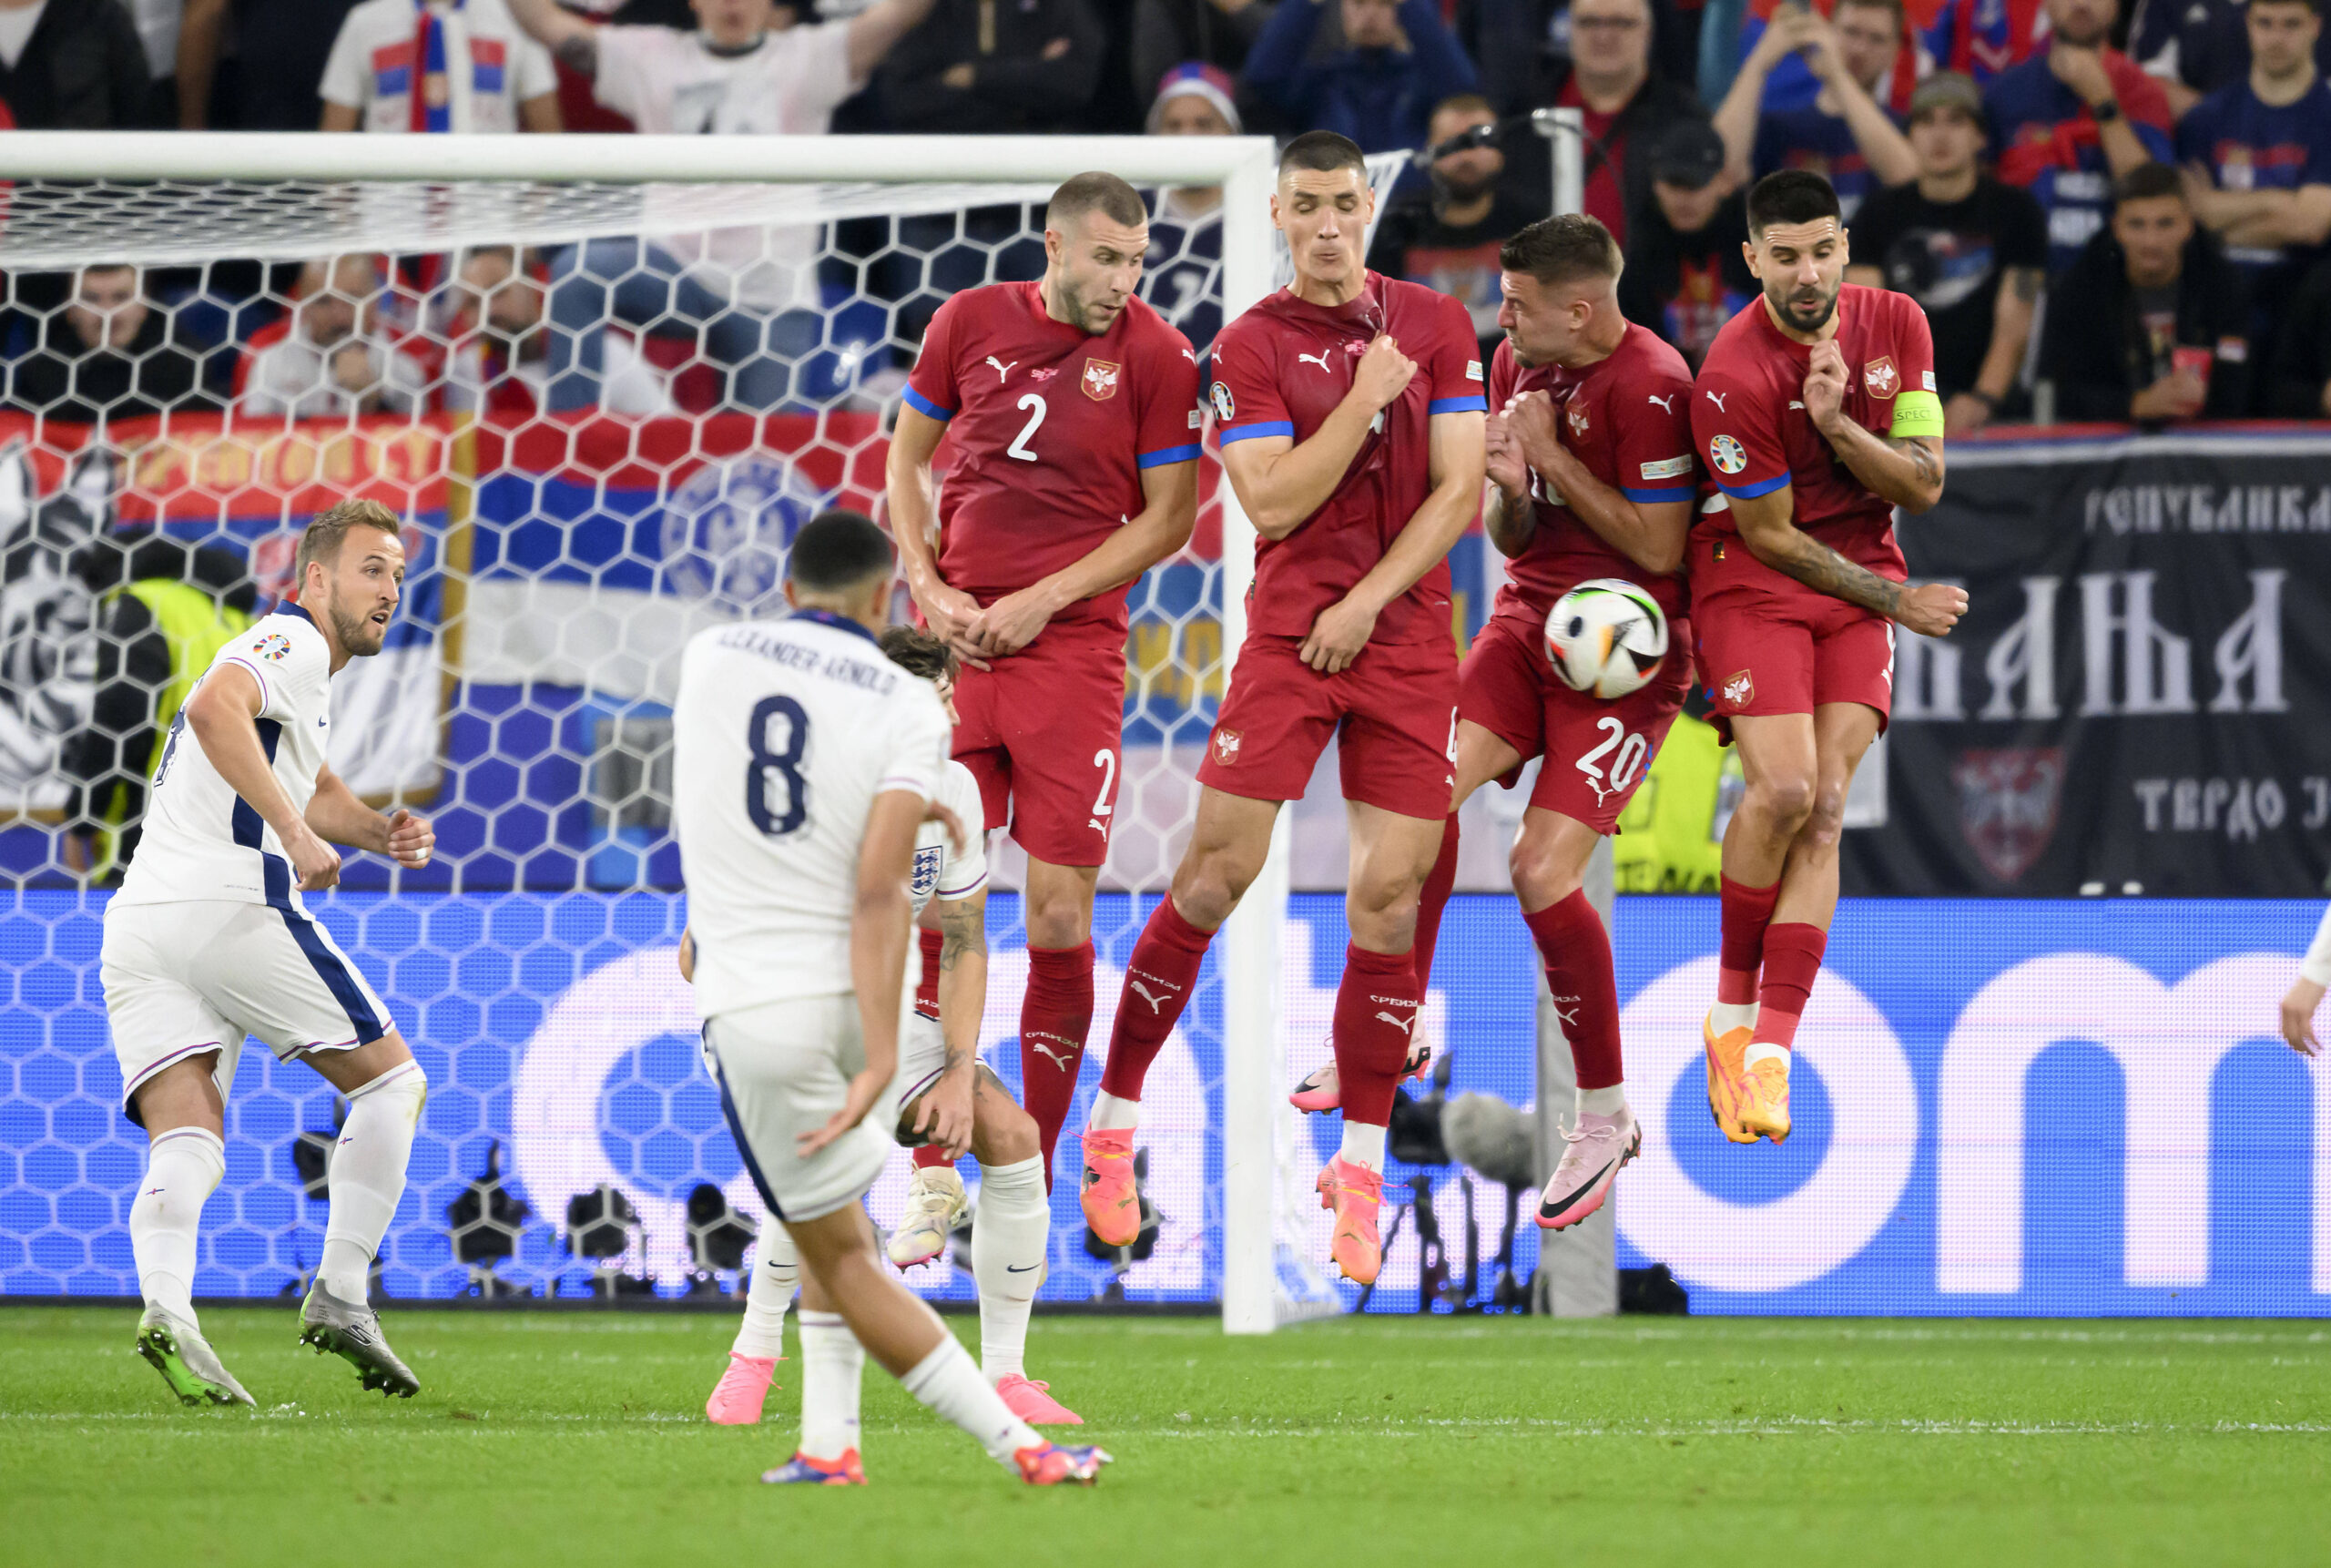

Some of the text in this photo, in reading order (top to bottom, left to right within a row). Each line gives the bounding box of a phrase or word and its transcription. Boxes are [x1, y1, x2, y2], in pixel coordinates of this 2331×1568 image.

[1006, 392, 1047, 462] 2
[747, 694, 809, 836] 8
[1092, 748, 1115, 816] 2
[1574, 716, 1647, 792] 20
